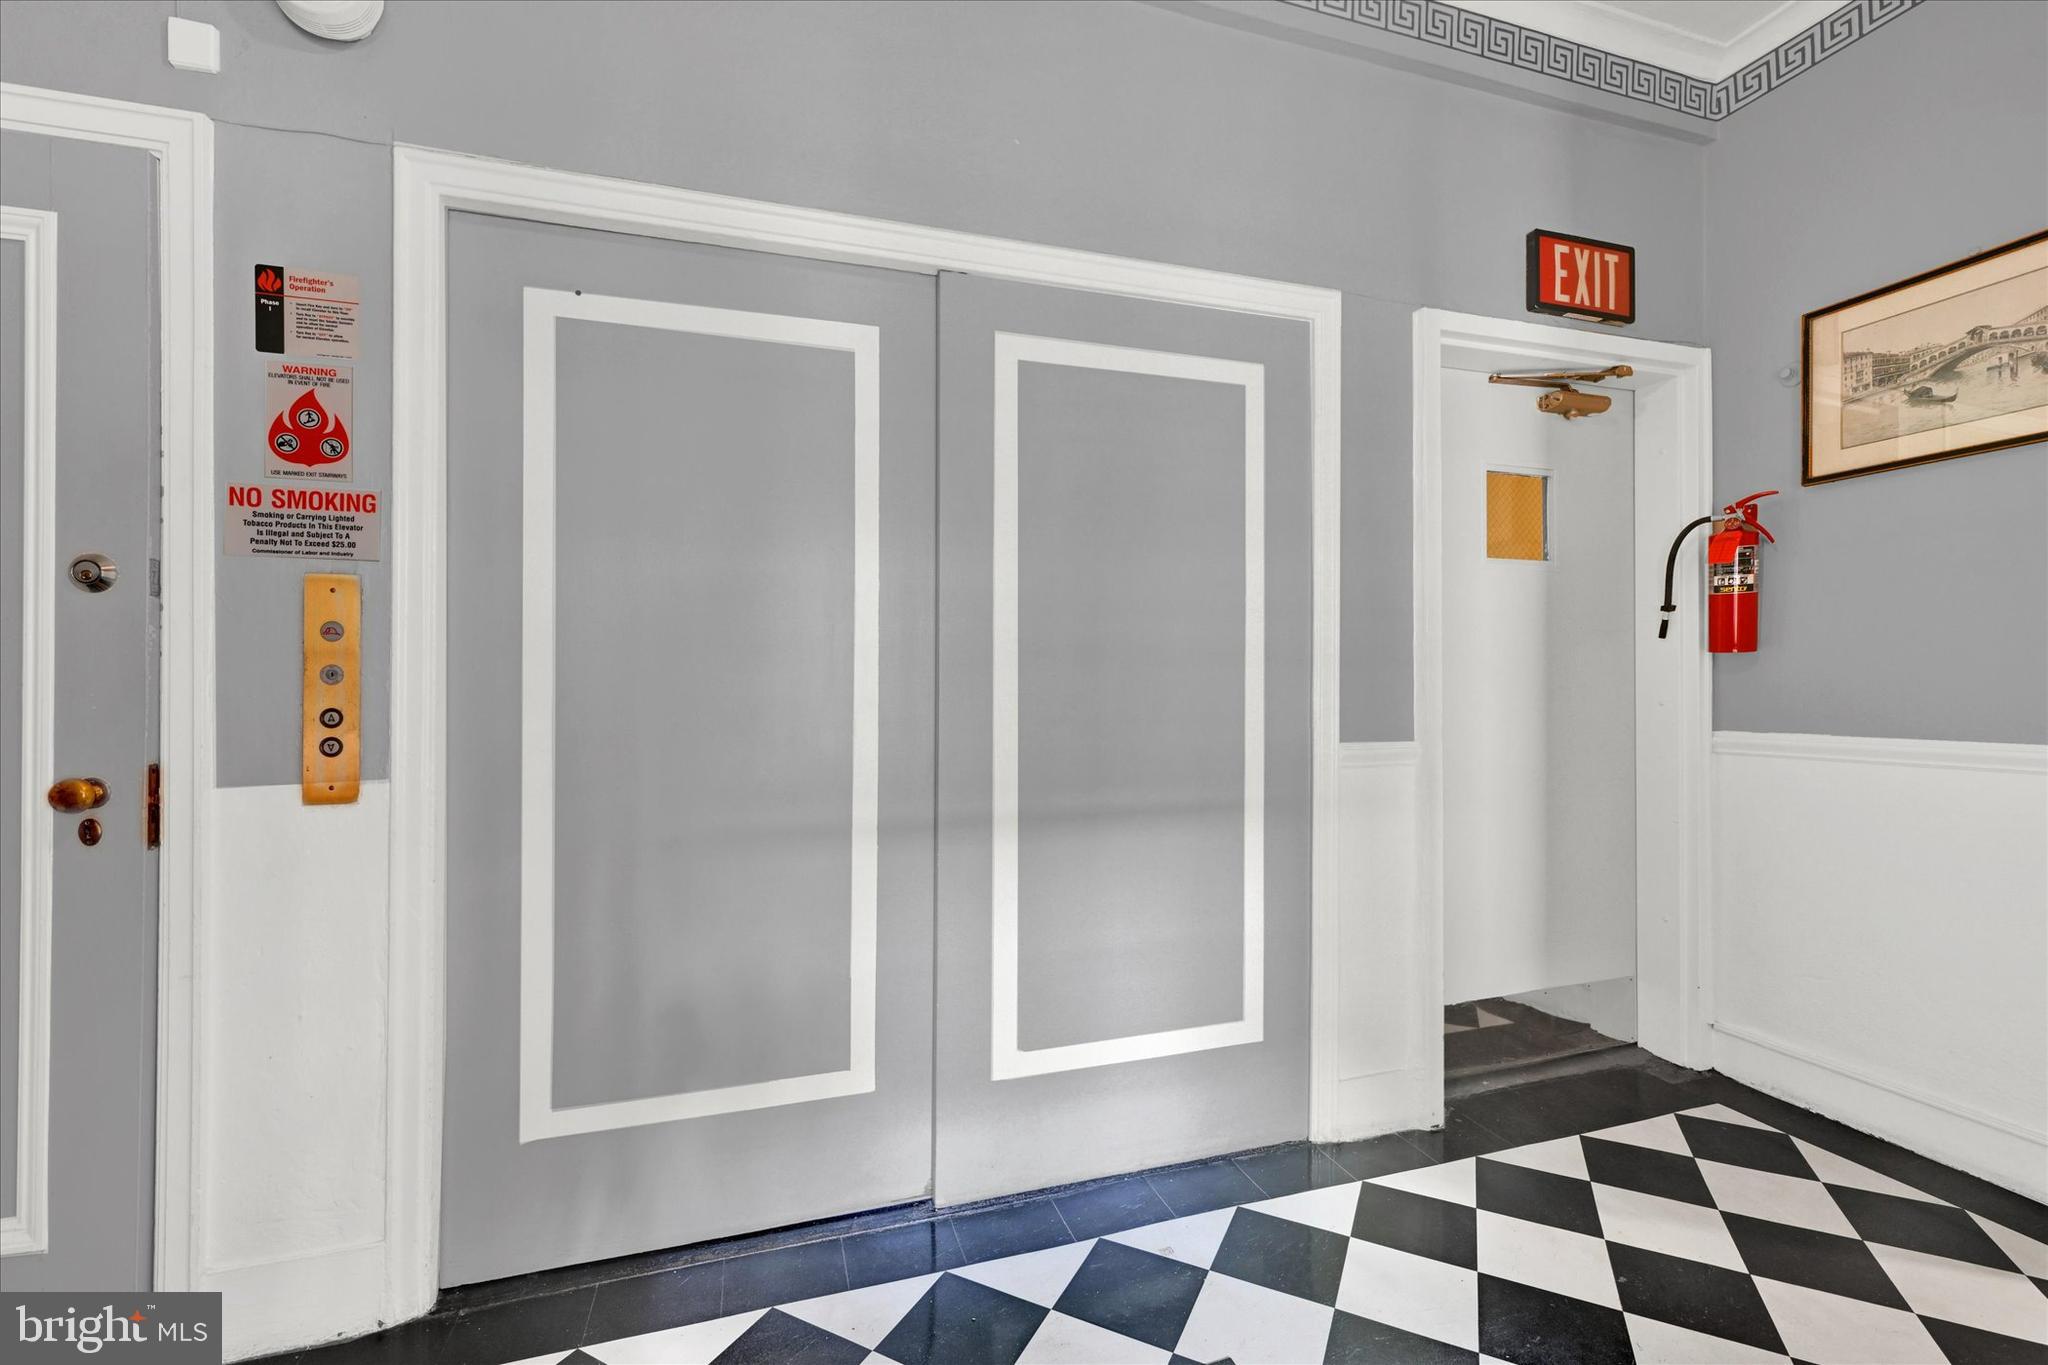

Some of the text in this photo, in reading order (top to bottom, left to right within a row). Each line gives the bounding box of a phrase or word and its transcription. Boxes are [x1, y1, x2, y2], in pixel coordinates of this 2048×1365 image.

[289, 275, 334, 287] Firefighter's
[1554, 243, 1619, 310] EXIT
[289, 283, 326, 294] Operation
[260, 298, 280, 306] Phase
[268, 372, 297, 380] ELEVATORS
[282, 364, 337, 377] WARNING
[229, 486, 376, 513] NO SMOKING
[252, 511, 285, 520] Smoking
[296, 513, 327, 522] Carrying
[329, 514, 355, 523] Lighted
[243, 519, 273, 527] Tobacco
[275, 520, 307, 529] Products
[318, 522, 333, 530] This
[265, 529, 289, 538] Illegal
[306, 531, 334, 540] Subject
[250, 537, 278, 546] Penalty
